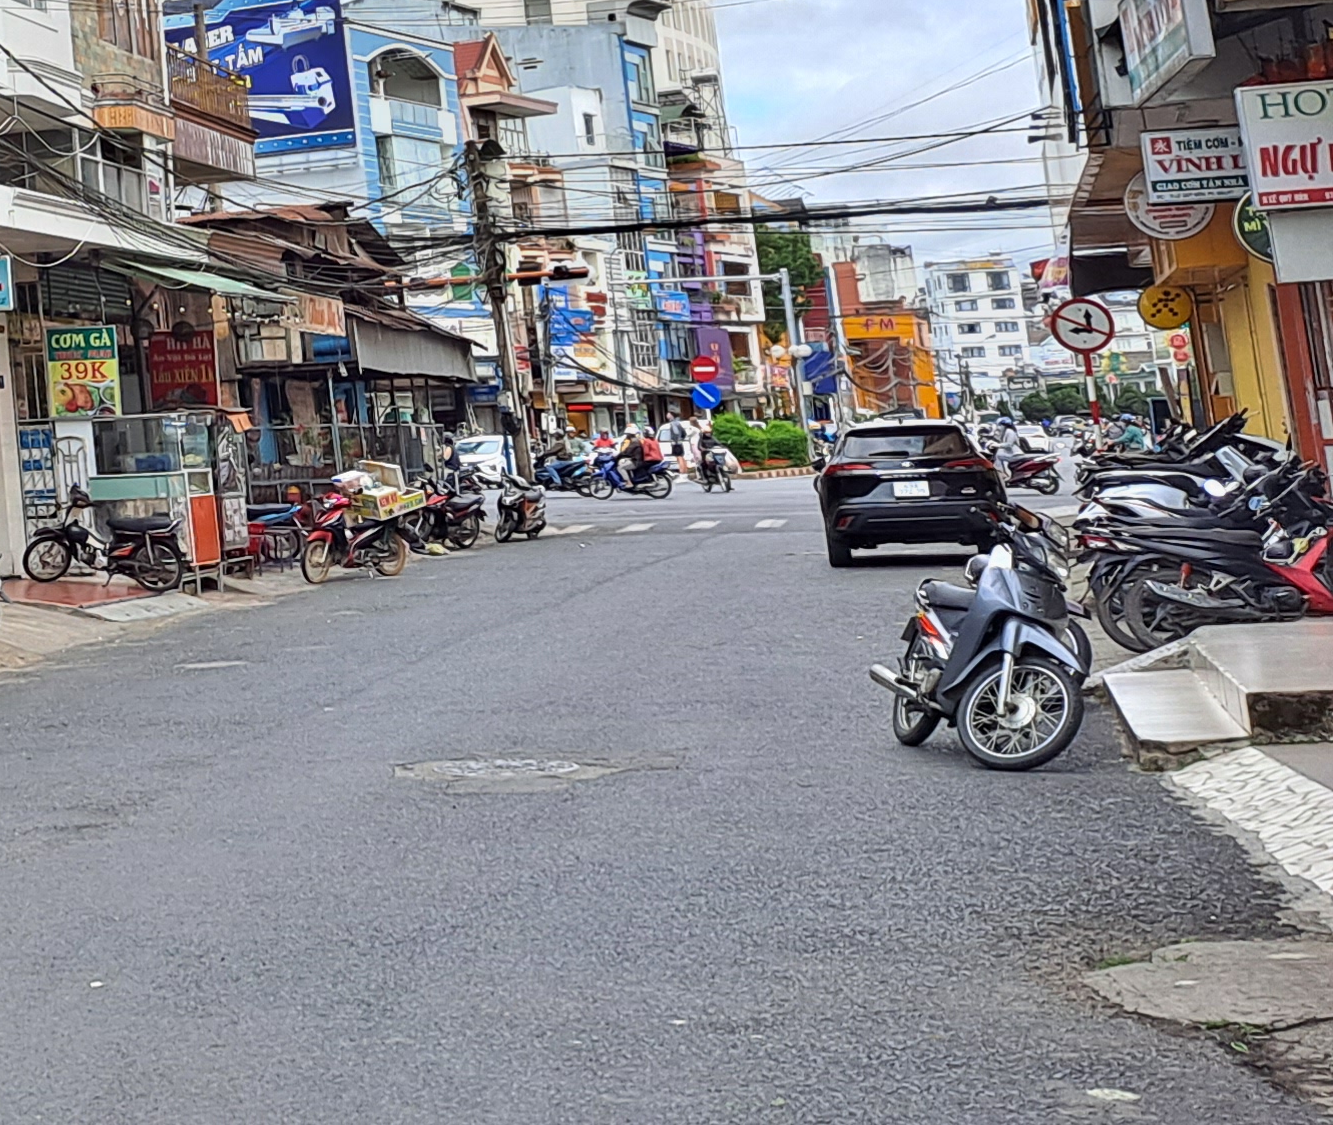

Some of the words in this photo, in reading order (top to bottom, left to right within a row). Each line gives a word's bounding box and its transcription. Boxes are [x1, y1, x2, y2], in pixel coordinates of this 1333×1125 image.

[1256, 88, 1333, 119] HO
[1175, 138, 1203, 154] TIỆM
[1205, 136, 1229, 149] CƠM
[1155, 155, 1224, 174] VĨNH
[1259, 137, 1323, 181] NGỰ
[51, 333, 86, 348] CƠM
[89, 328, 111, 347] GÀ
[60, 361, 109, 380] 39K
